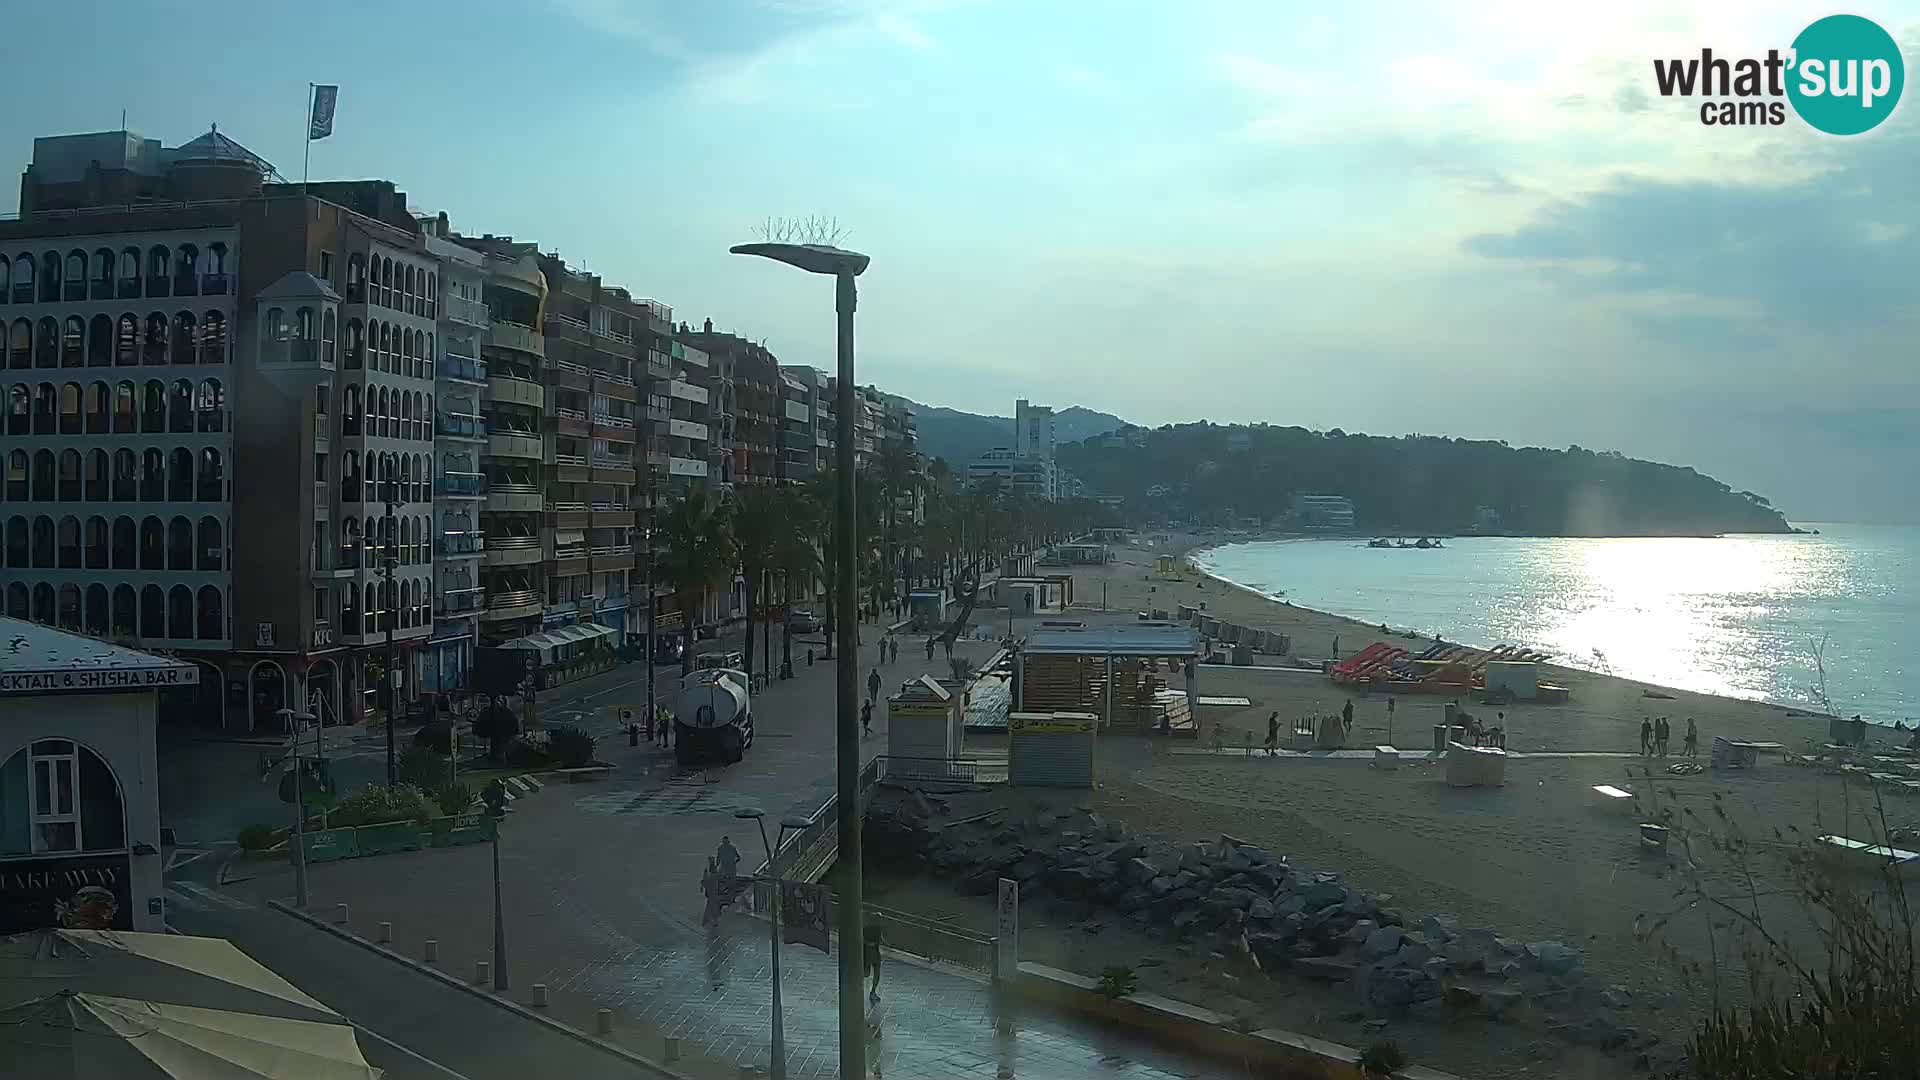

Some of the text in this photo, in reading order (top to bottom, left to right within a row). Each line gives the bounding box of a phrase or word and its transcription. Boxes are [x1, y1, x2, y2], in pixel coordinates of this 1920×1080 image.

[314, 629, 332, 646] KFC
[64, 673, 74, 687] &
[80, 671, 141, 687] SHISHA
[147, 670, 180, 684] BAR
